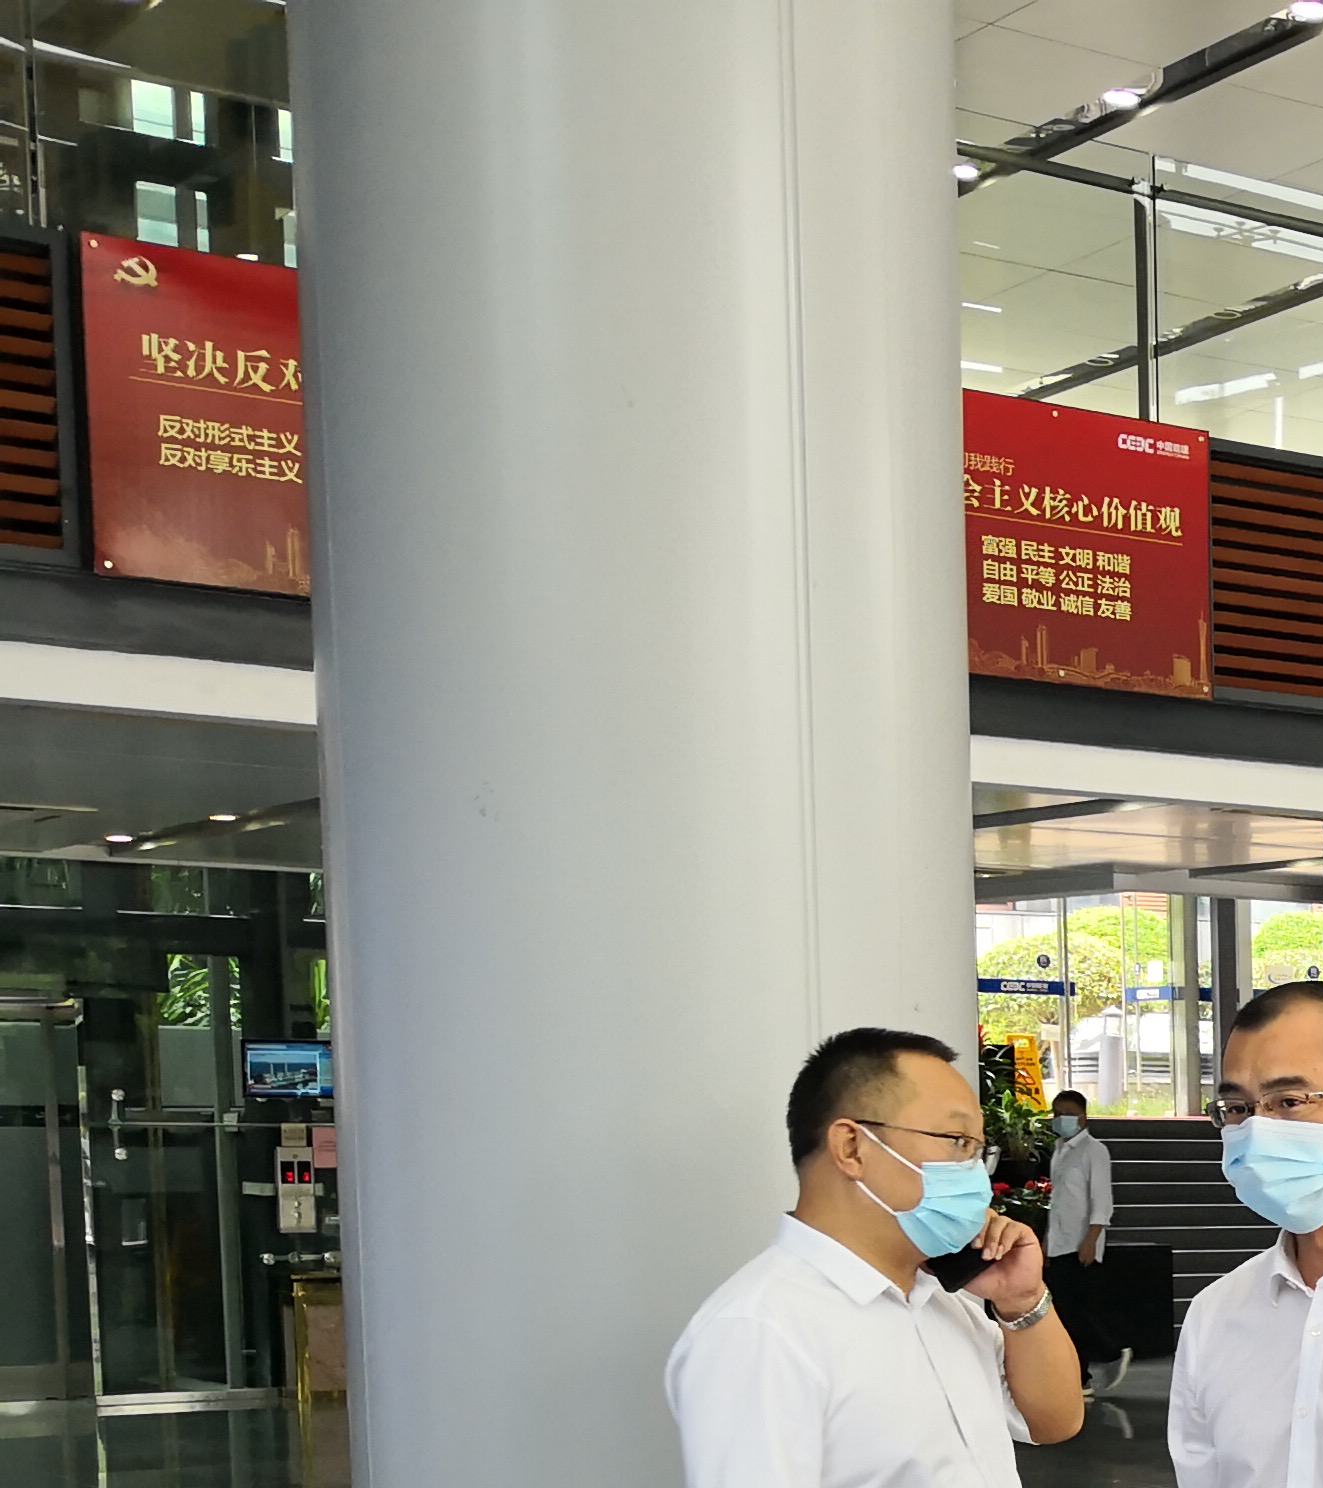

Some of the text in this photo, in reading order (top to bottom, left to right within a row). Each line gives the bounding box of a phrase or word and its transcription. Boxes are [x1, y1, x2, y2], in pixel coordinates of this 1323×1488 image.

[157, 414, 303, 457] 反对形式主义
[158, 443, 304, 484] 反对享乐主义
[964, 452, 1016, 477] 我践行
[981, 535, 1132, 575] 富强 民主 文明 和谐
[982, 559, 1132, 598] 自由 平等 公正 法治
[982, 584, 1133, 621] 爱国 敬业 诚信 友善
